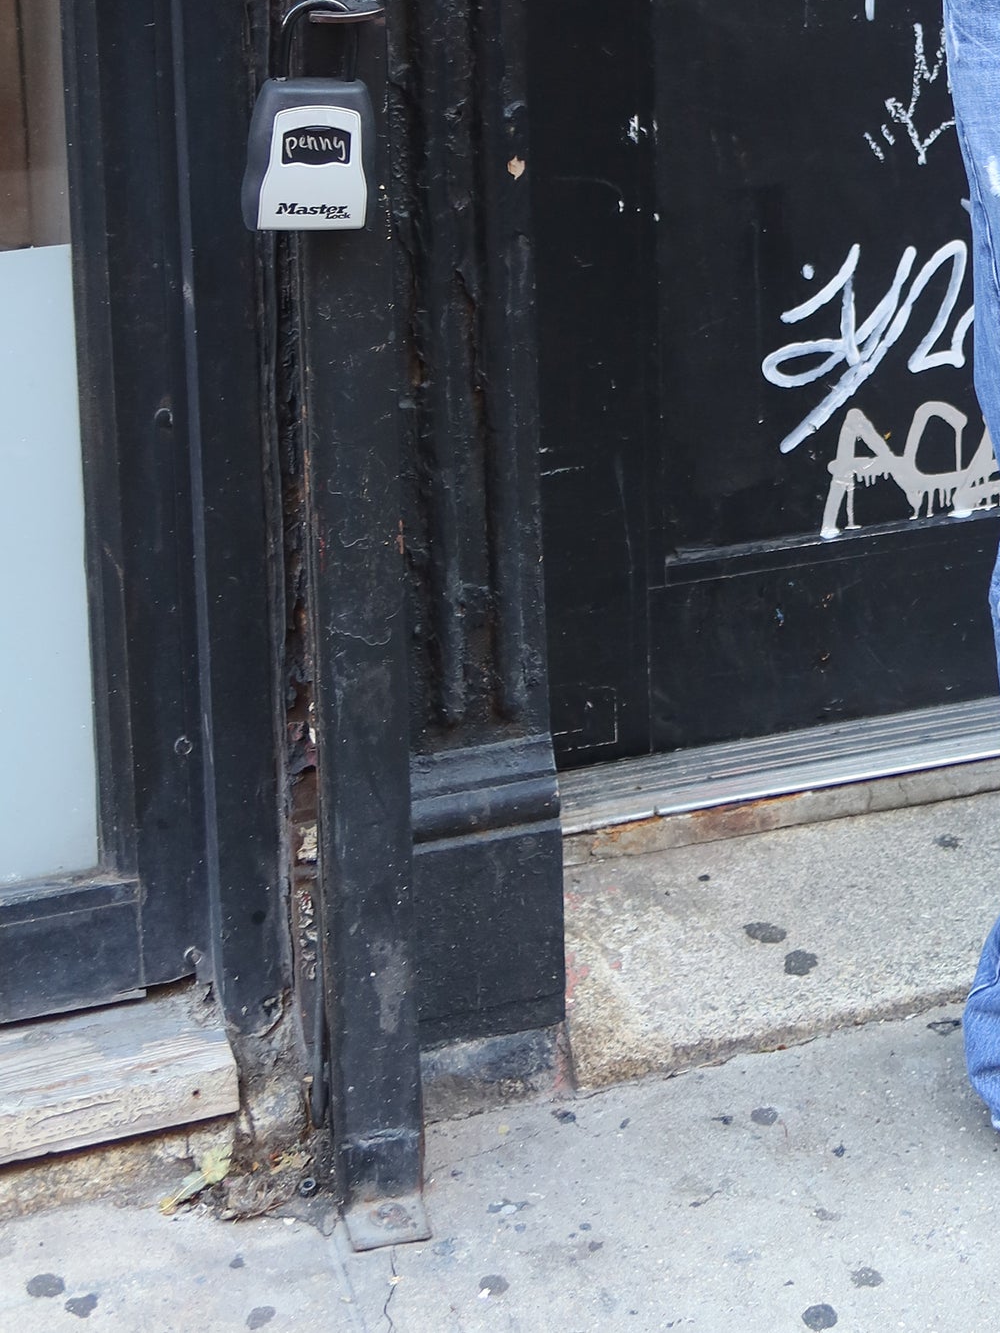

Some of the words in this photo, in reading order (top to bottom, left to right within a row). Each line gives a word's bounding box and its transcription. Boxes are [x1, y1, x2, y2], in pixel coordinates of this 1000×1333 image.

[285, 134, 346, 162] penny
[275, 202, 348, 215] Master
[325, 212, 352, 220] Lock
